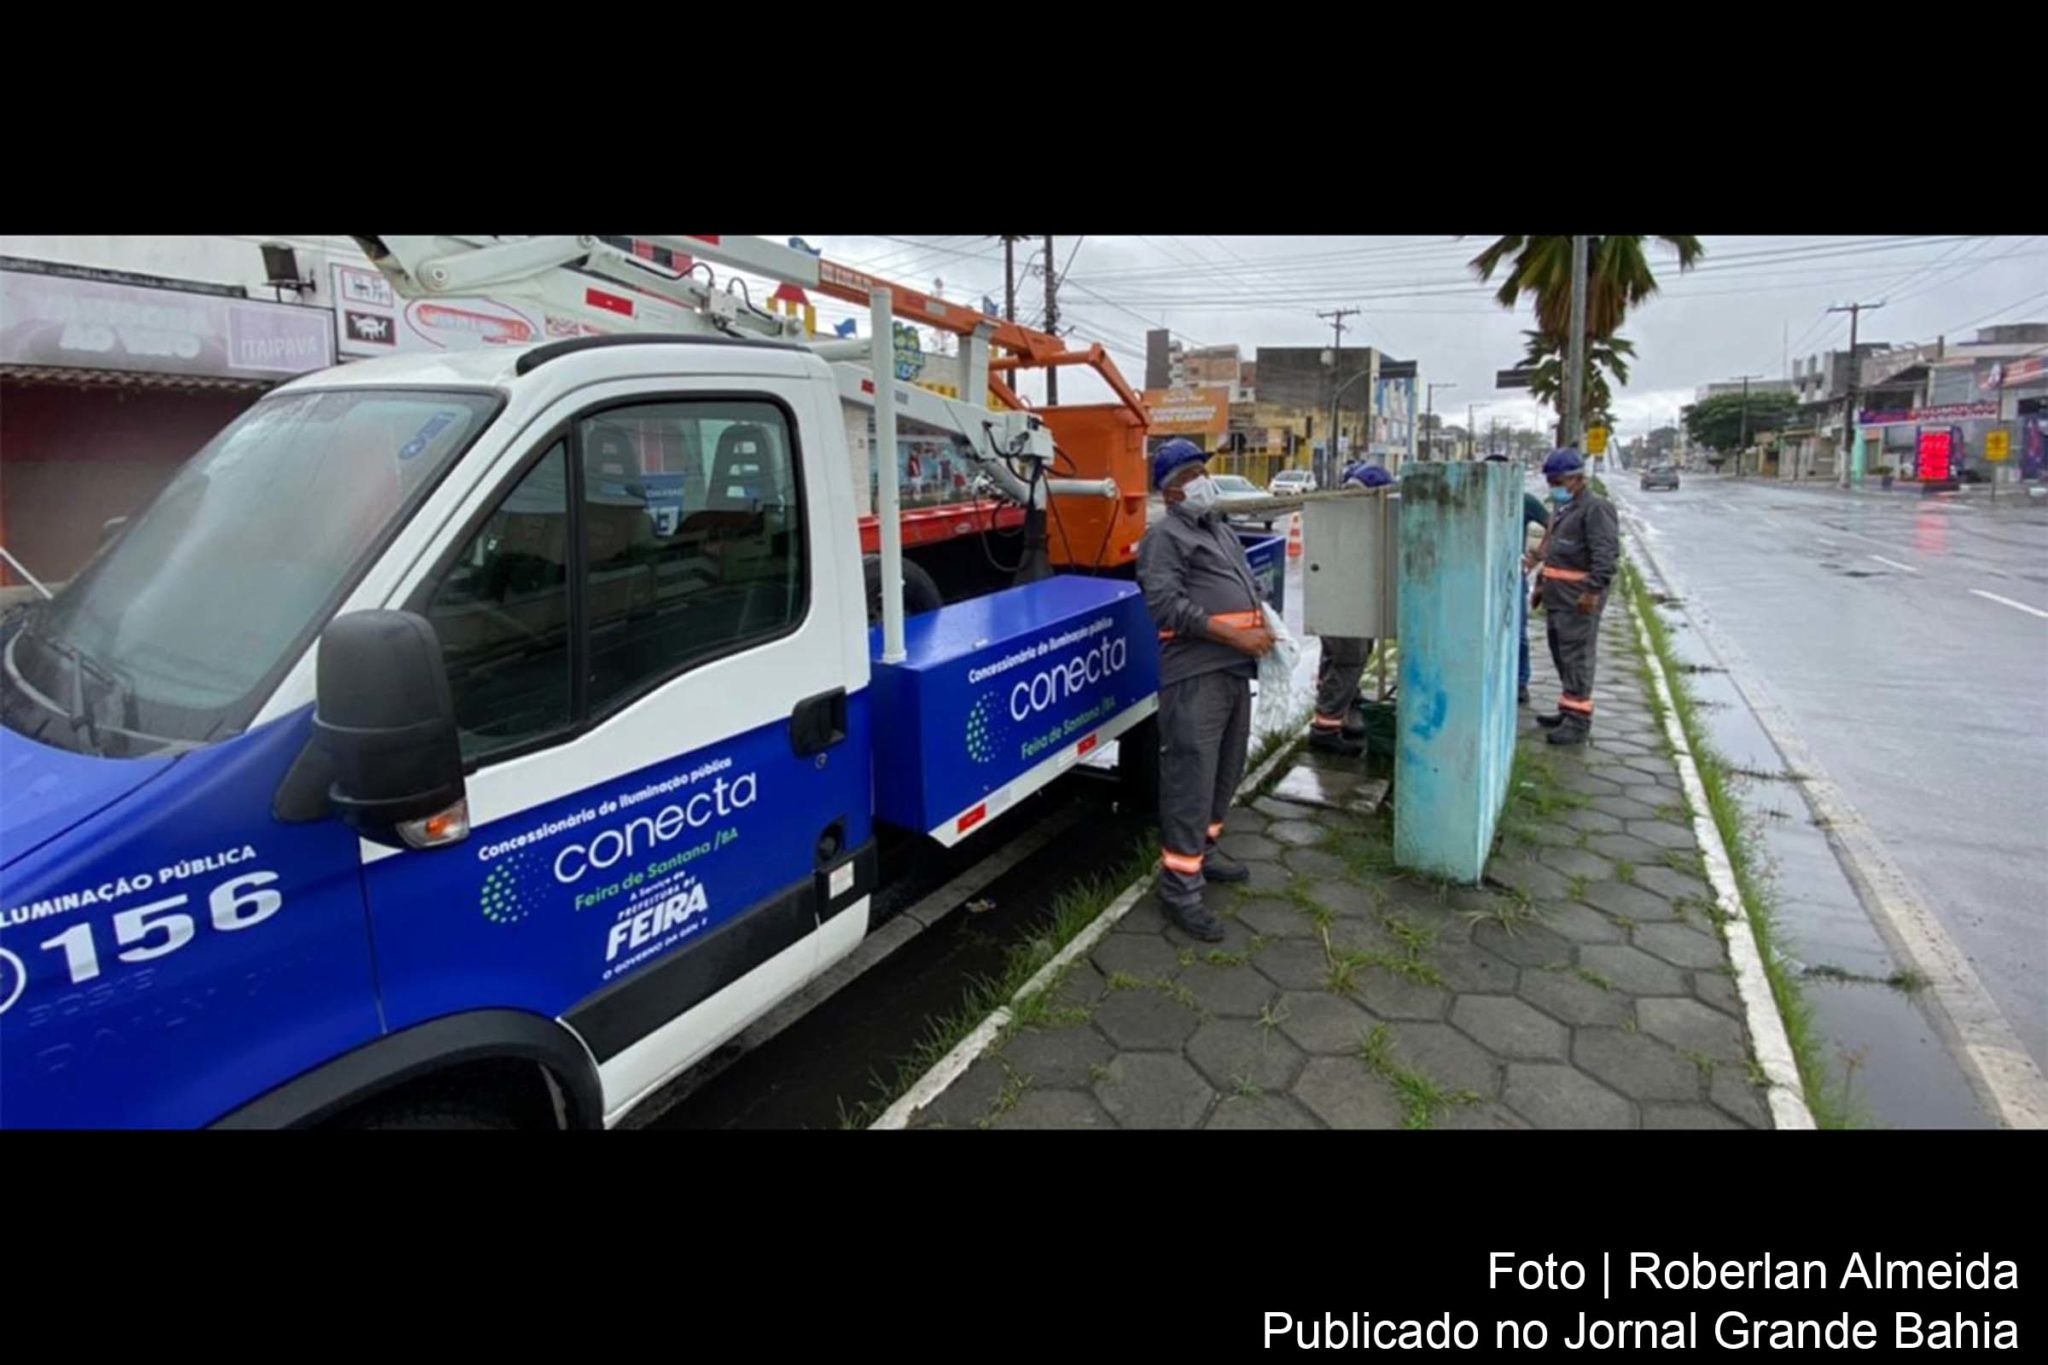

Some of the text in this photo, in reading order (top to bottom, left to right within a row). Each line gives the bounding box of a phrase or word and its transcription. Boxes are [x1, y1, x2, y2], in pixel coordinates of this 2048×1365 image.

[240, 334, 318, 360] ITAIPAVA
[1010, 636, 1126, 721] conecta
[478, 808, 597, 861] Concessionária
[599, 800, 617, 816] de
[690, 757, 733, 784] pública
[553, 770, 758, 884] conecta
[0, 844, 257, 928] LUMINAÇÃO PÚBLICA
[575, 883, 619, 911] Feira
[622, 872, 644, 890] de
[647, 841, 710, 878] Santana
[40, 870, 283, 984] 156
[605, 881, 709, 963] FEIRA
